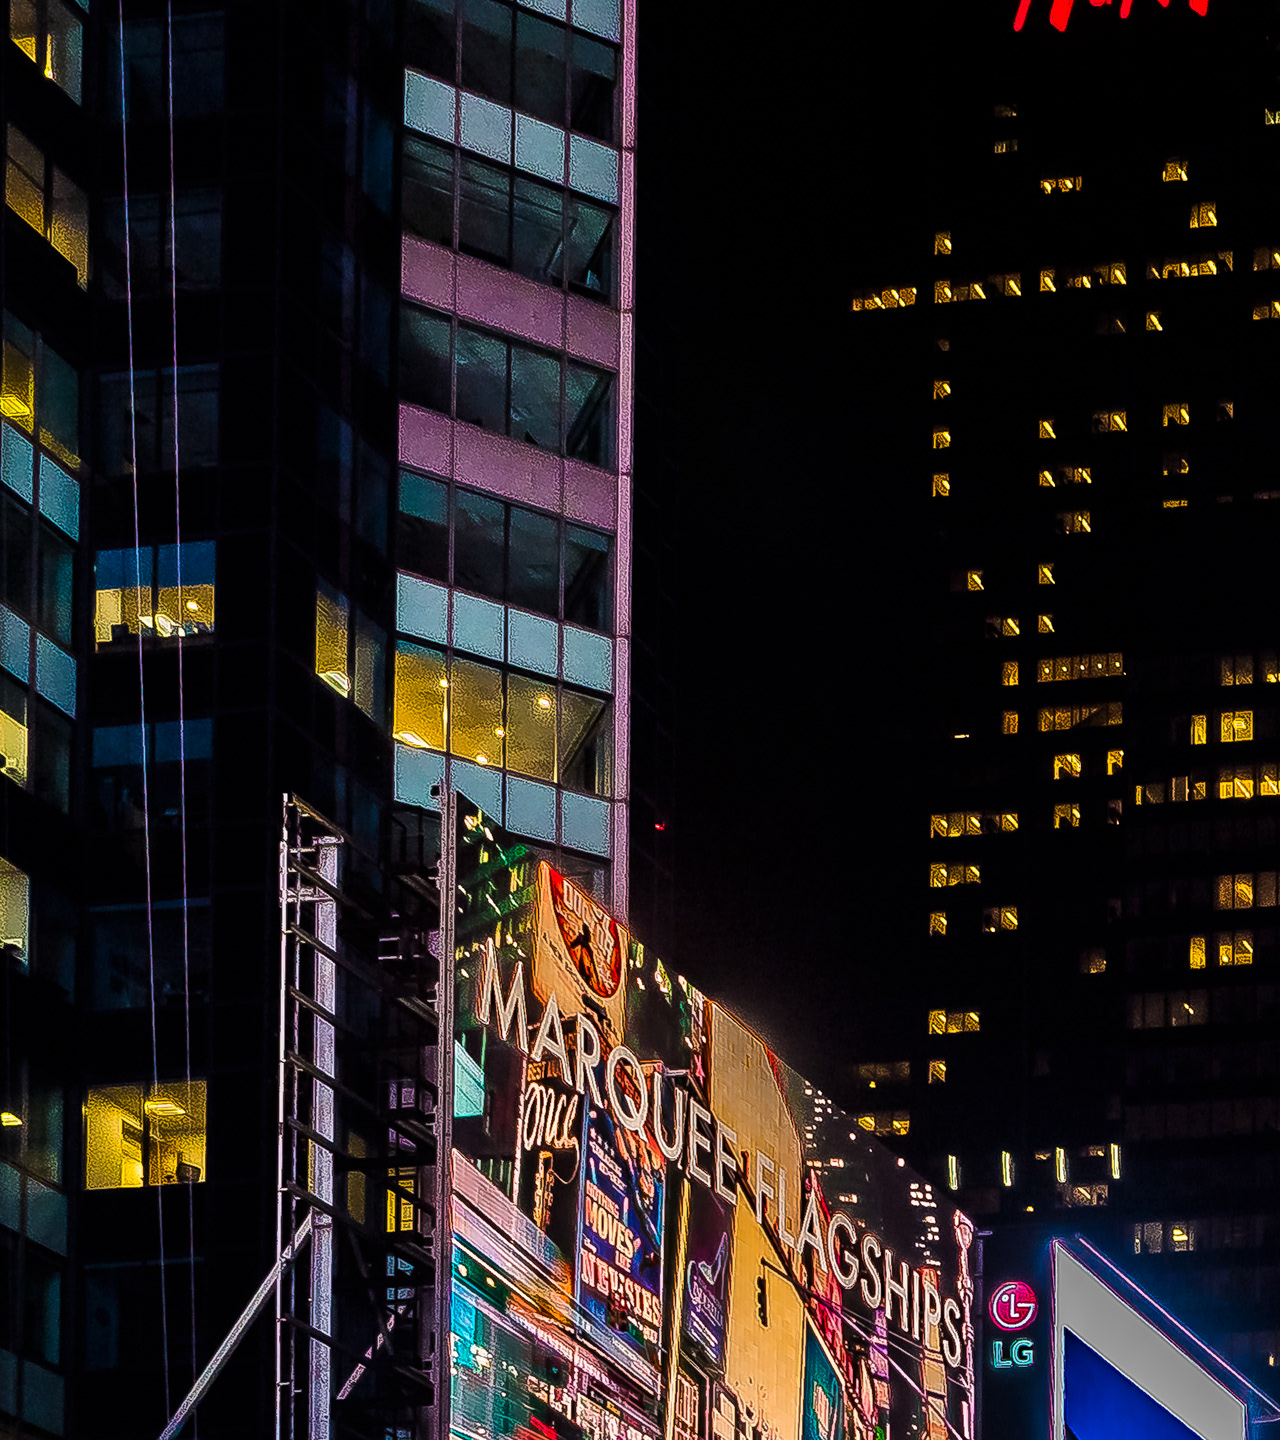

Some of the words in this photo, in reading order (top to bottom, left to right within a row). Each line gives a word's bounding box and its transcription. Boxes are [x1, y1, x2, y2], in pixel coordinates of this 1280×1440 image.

[475, 936, 738, 1206] MARQUEE
[755, 1150, 961, 1368] FLAGSHIPS
[585, 1196, 635, 1259] MOVES
[992, 1338, 1035, 1369] LG
